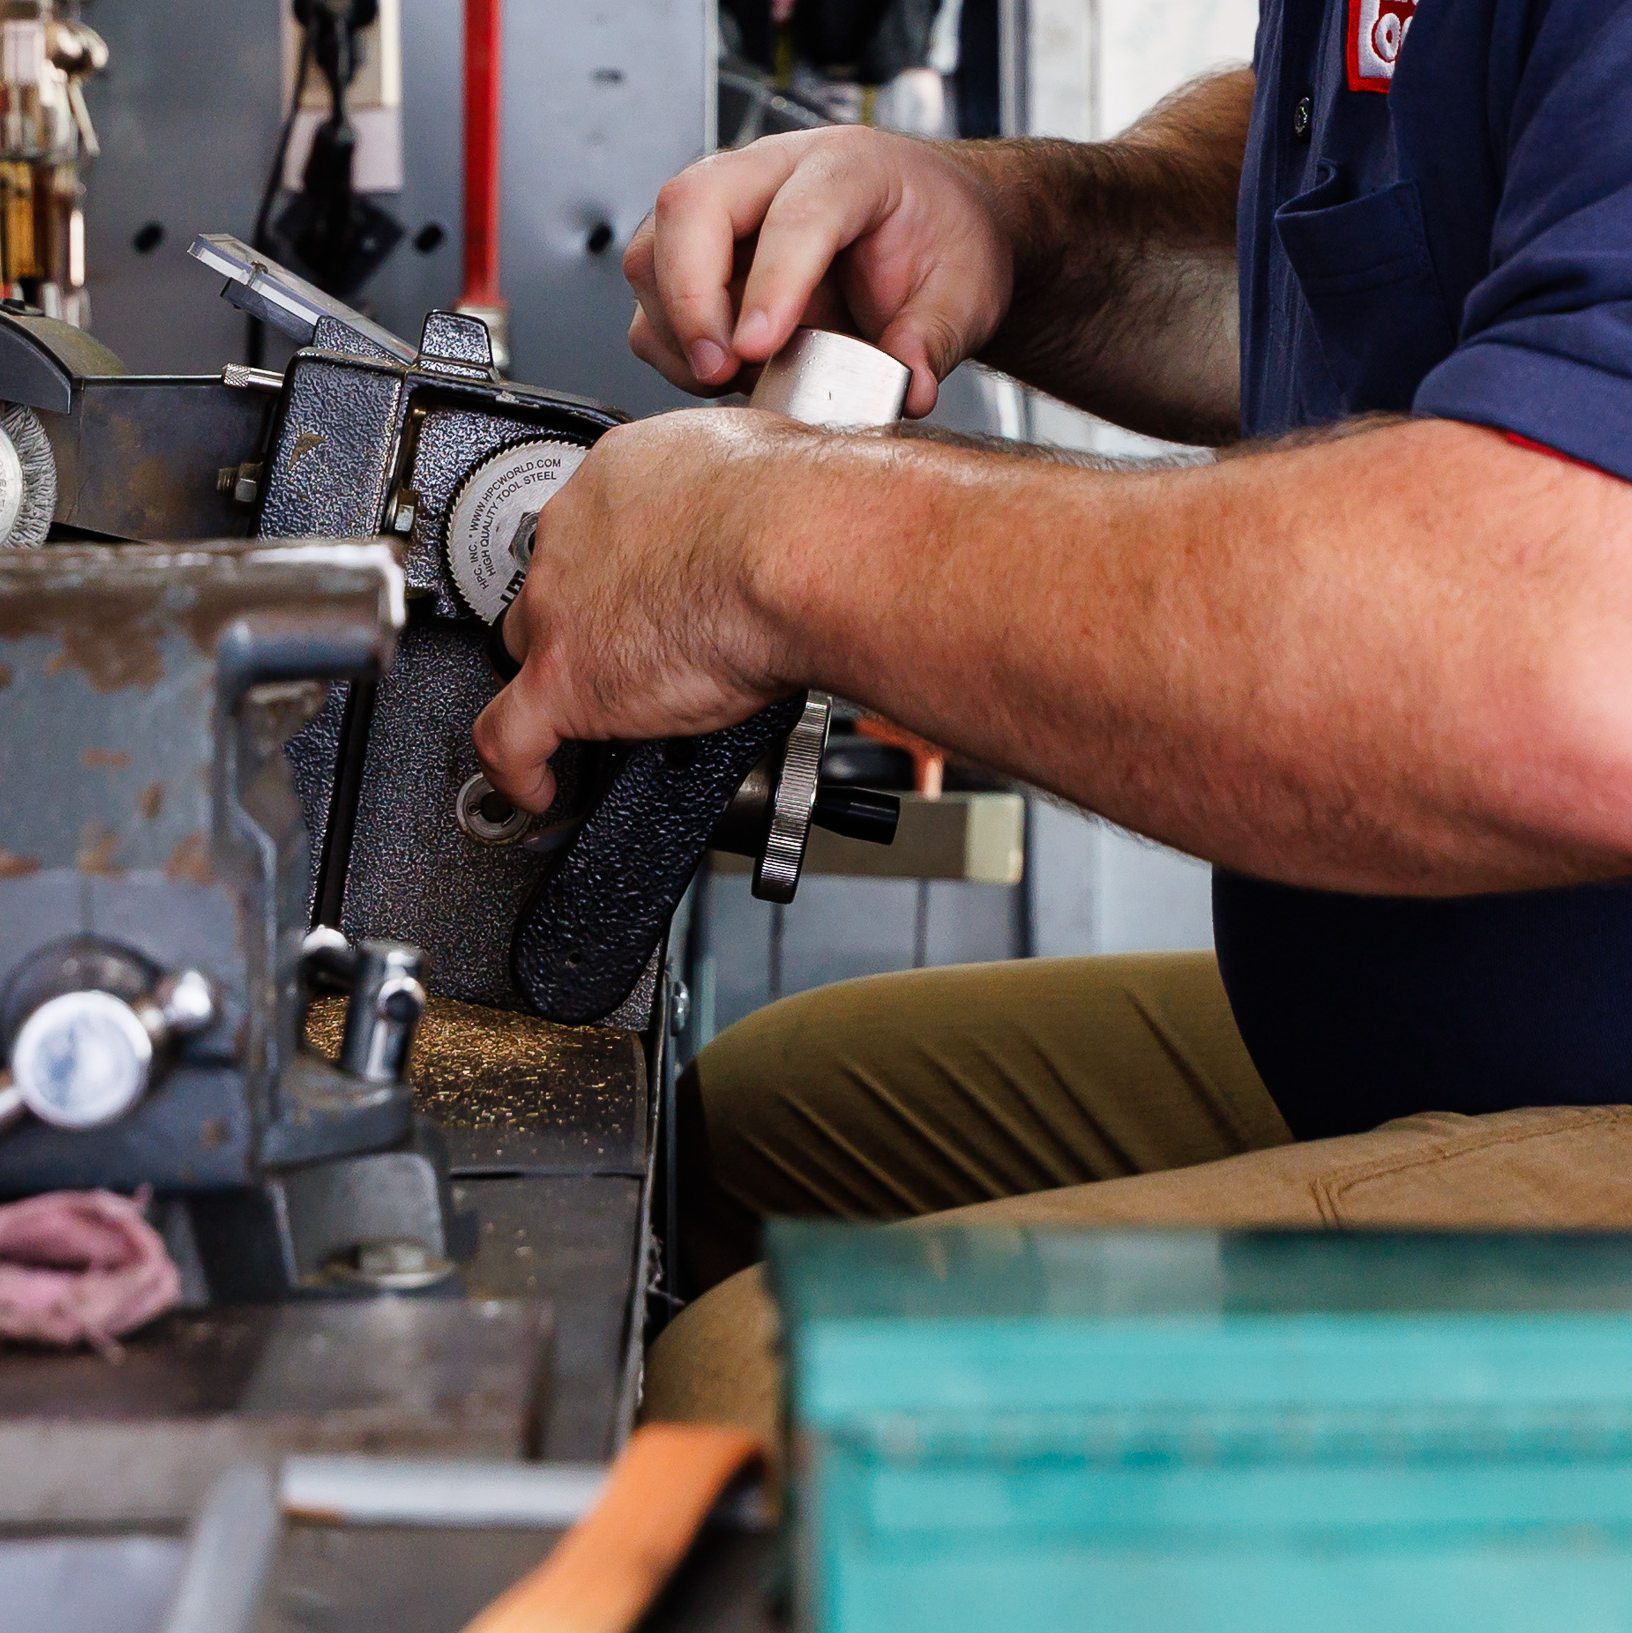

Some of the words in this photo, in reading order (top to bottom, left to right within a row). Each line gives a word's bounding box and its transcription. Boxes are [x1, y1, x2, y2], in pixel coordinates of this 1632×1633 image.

[523, 471, 557, 485] STEEL
[469, 458, 561, 531] WWW.HPCWORLD.COM
[496, 482, 523, 503] TOOL
[480, 503, 499, 547] QUALITY
[468, 541, 479, 563] INC.
[482, 549, 496, 577] HIGH
